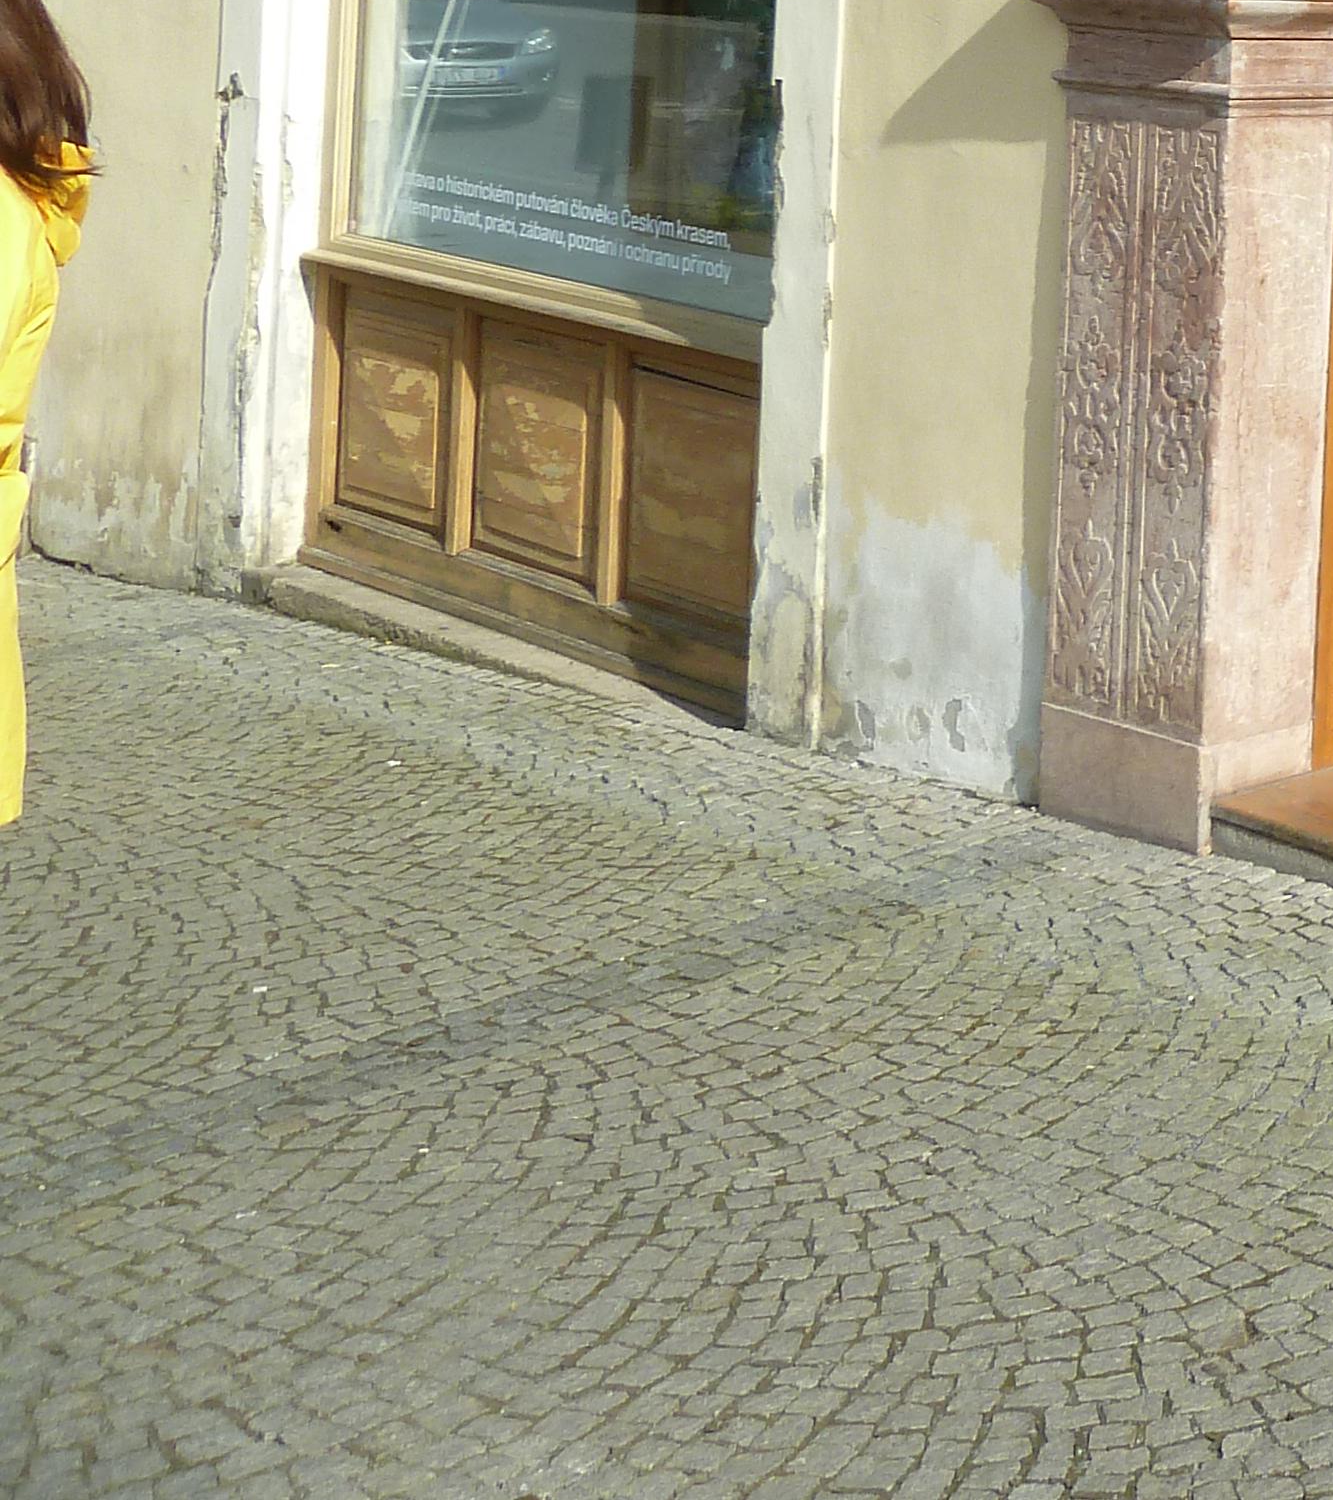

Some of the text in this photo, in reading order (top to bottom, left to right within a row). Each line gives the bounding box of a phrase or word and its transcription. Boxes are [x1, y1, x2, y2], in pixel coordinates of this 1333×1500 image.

[431, 204, 451, 222] pro
[625, 244, 679, 271] ochranu
[682, 253, 732, 285] přírody
[446, 174, 515, 205] historickém
[570, 198, 618, 227] člověka
[621, 204, 675, 239] Českým
[677, 219, 731, 251] krasem,
